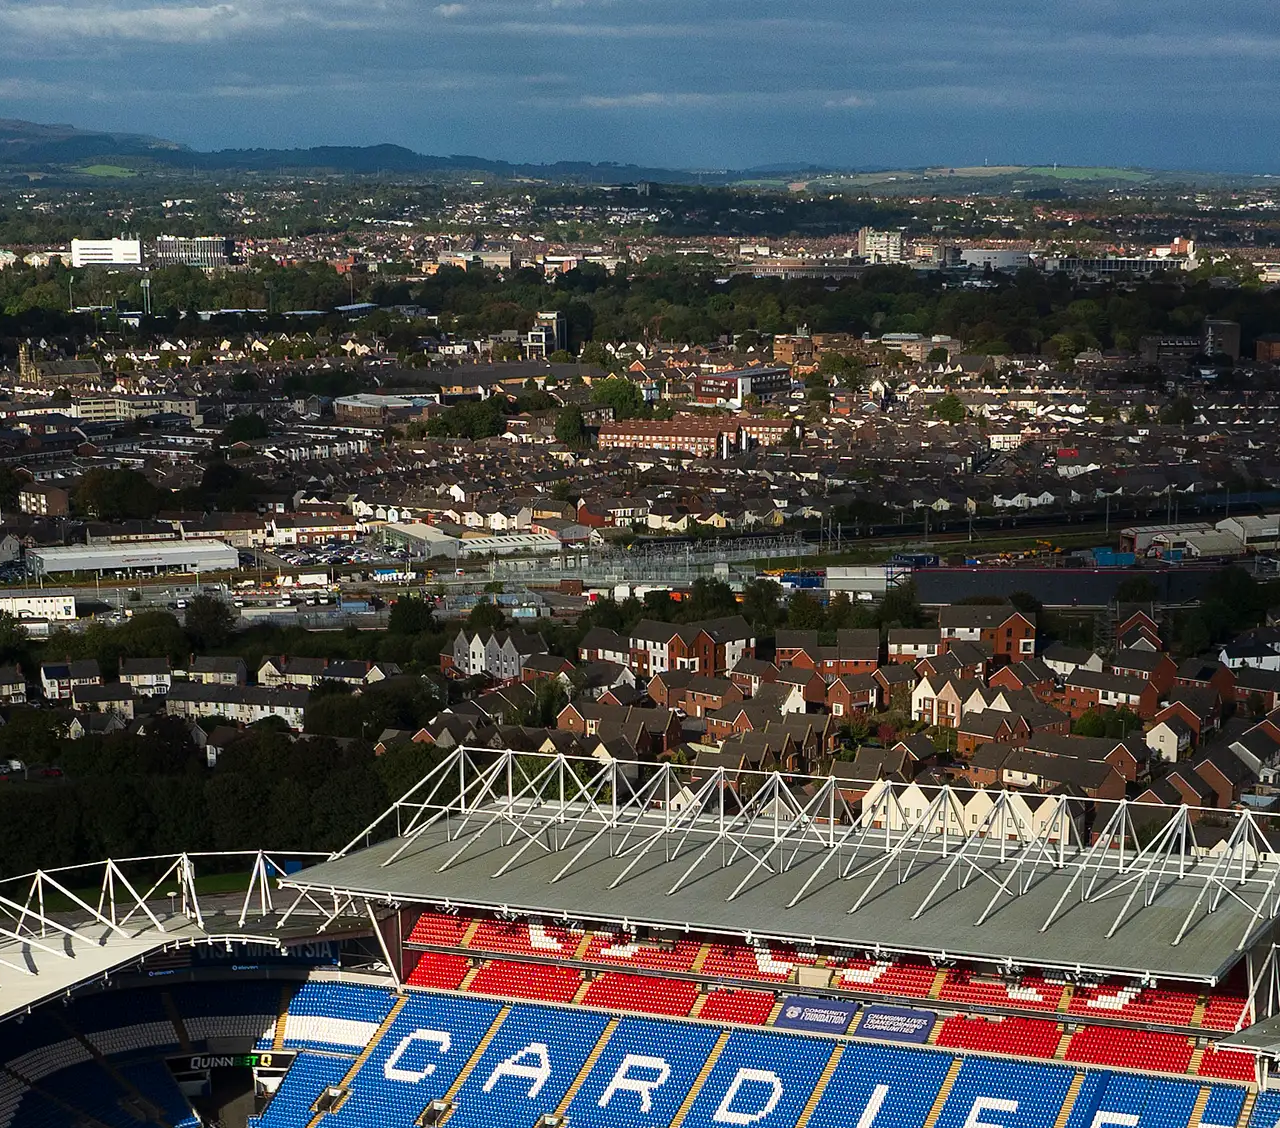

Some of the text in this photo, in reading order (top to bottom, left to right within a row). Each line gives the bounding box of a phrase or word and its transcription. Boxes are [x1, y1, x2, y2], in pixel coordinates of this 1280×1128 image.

[800, 1012, 847, 1025] FOUNDATION
[803, 1007, 849, 1018] COMMUNITY
[867, 1013, 908, 1024] CHANGING
[862, 1023, 916, 1035] COMMUNITIES
[866, 1018, 924, 1031] TRANSFORMING
[190, 1055, 259, 1070] QUINNBET
